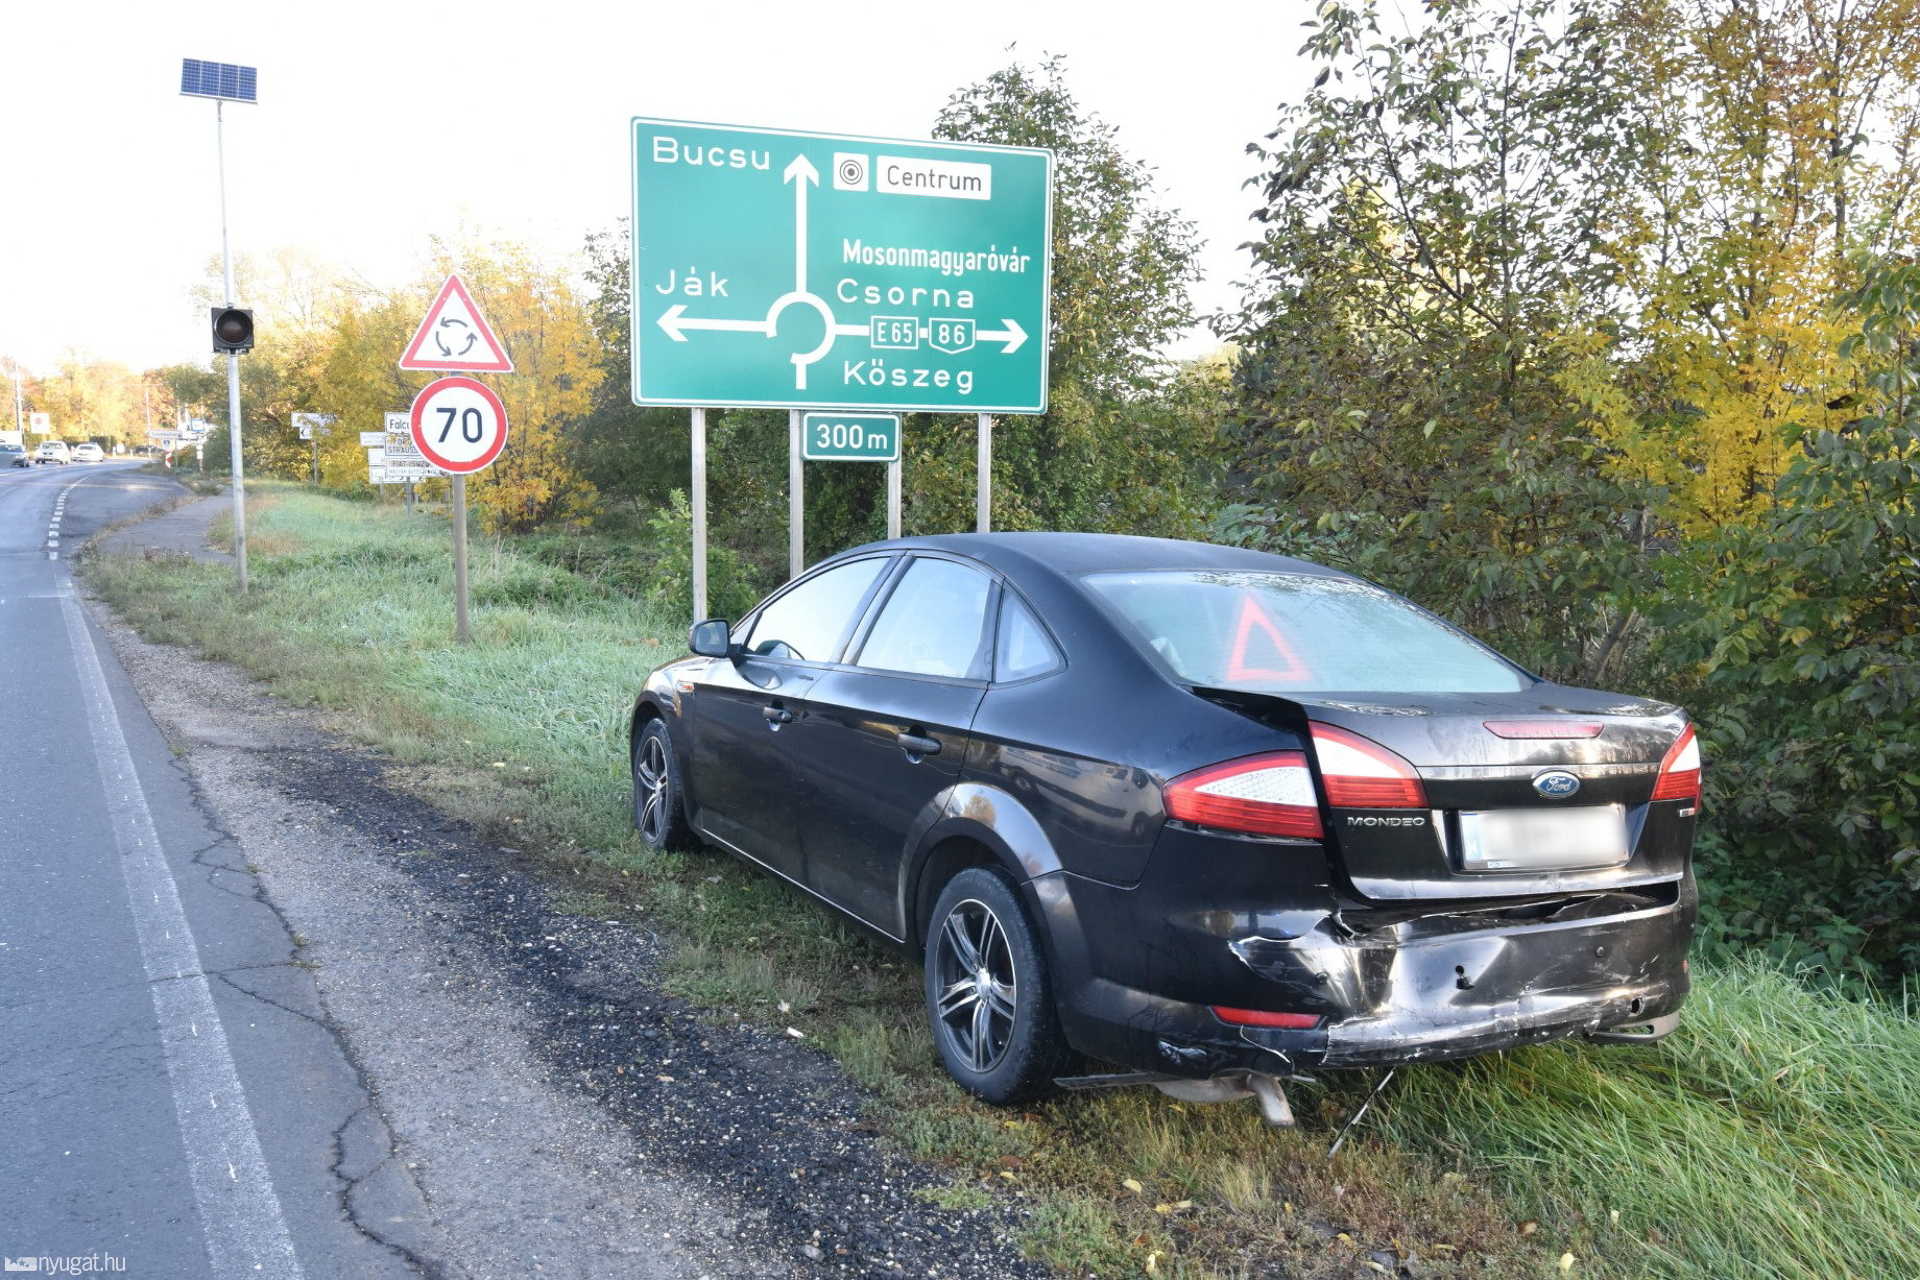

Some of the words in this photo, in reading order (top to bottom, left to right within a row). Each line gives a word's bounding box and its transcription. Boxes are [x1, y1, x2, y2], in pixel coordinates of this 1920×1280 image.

[652, 136, 771, 171] Bucsu
[886, 165, 982, 192] Centrum
[842, 238, 1031, 276] Mosonmagyaróvár
[655, 267, 729, 297] Ják
[837, 278, 975, 309] Csorna
[938, 323, 966, 346] 86
[843, 359, 975, 395] Kőszeg
[436, 407, 482, 443] 70
[1546, 775, 1573, 792] Ford
[1346, 816, 1425, 827] MONDEO
